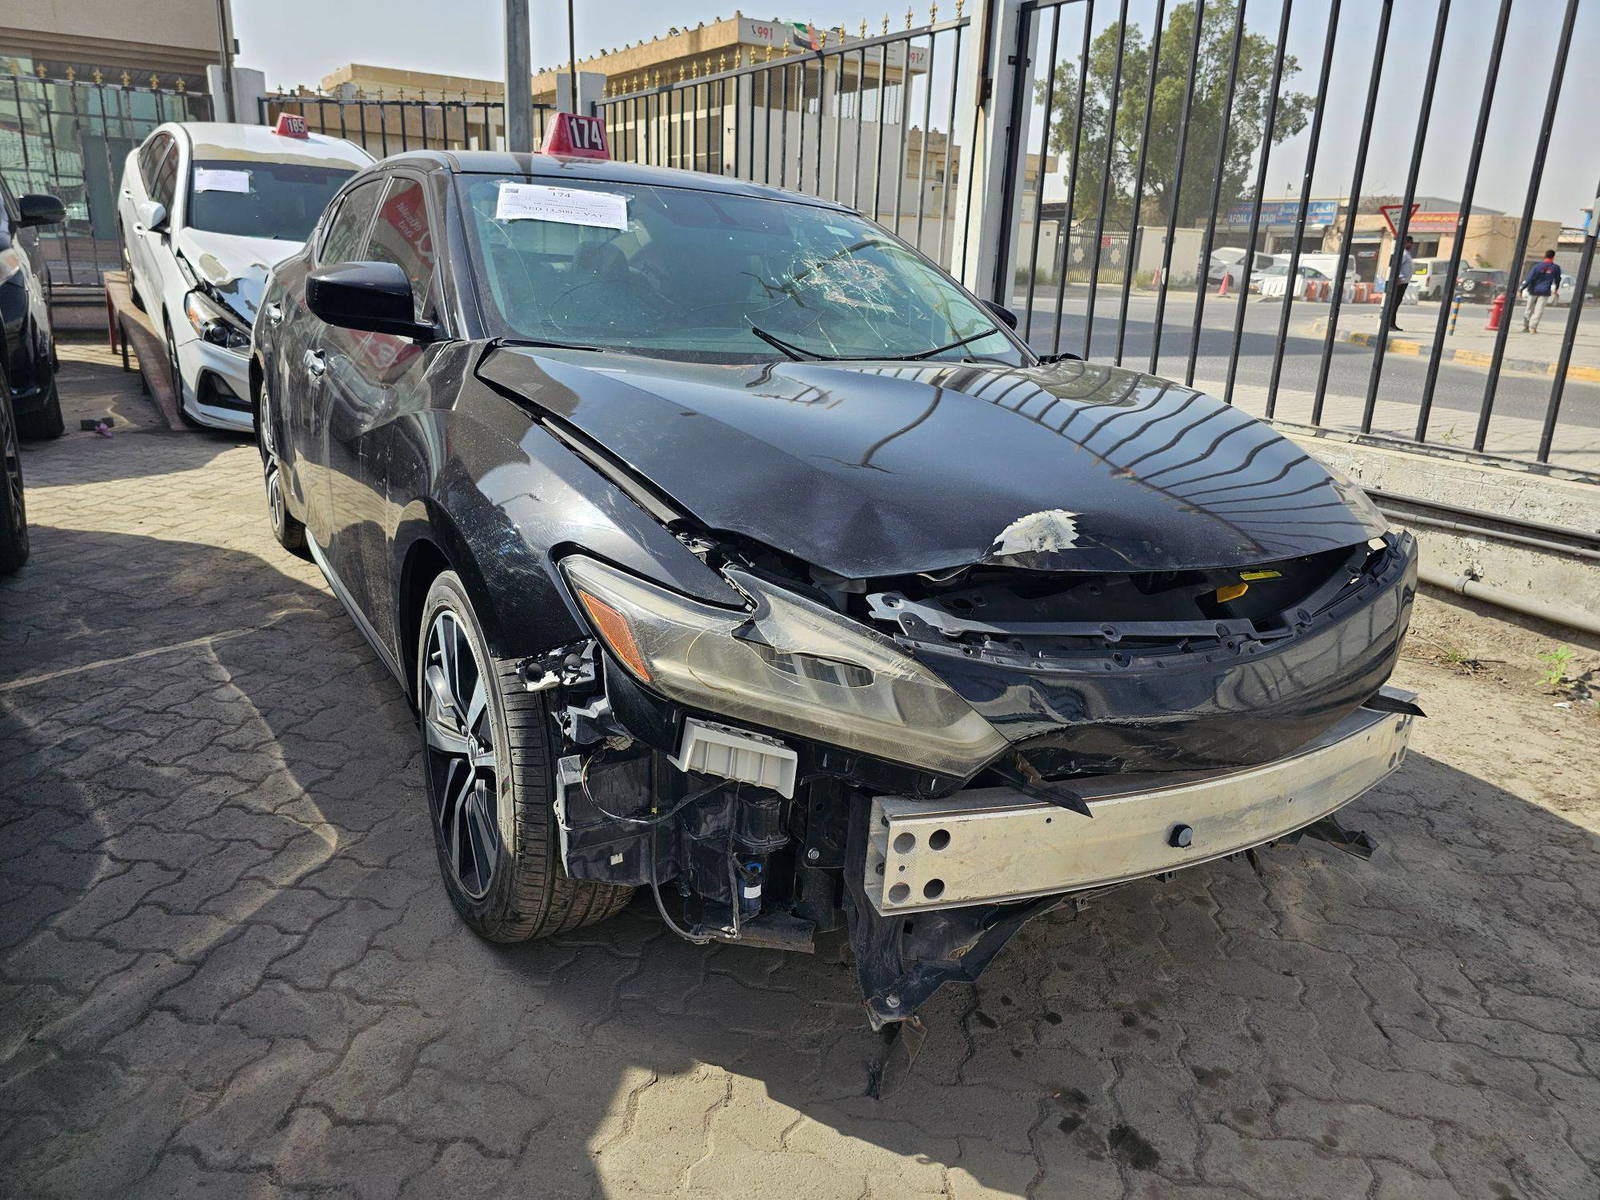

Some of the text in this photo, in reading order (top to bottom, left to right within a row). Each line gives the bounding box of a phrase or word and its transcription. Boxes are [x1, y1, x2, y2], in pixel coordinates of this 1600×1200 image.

[758, 26, 773, 39] 991
[288, 119, 304, 133] 185
[570, 118, 603, 150] 174
